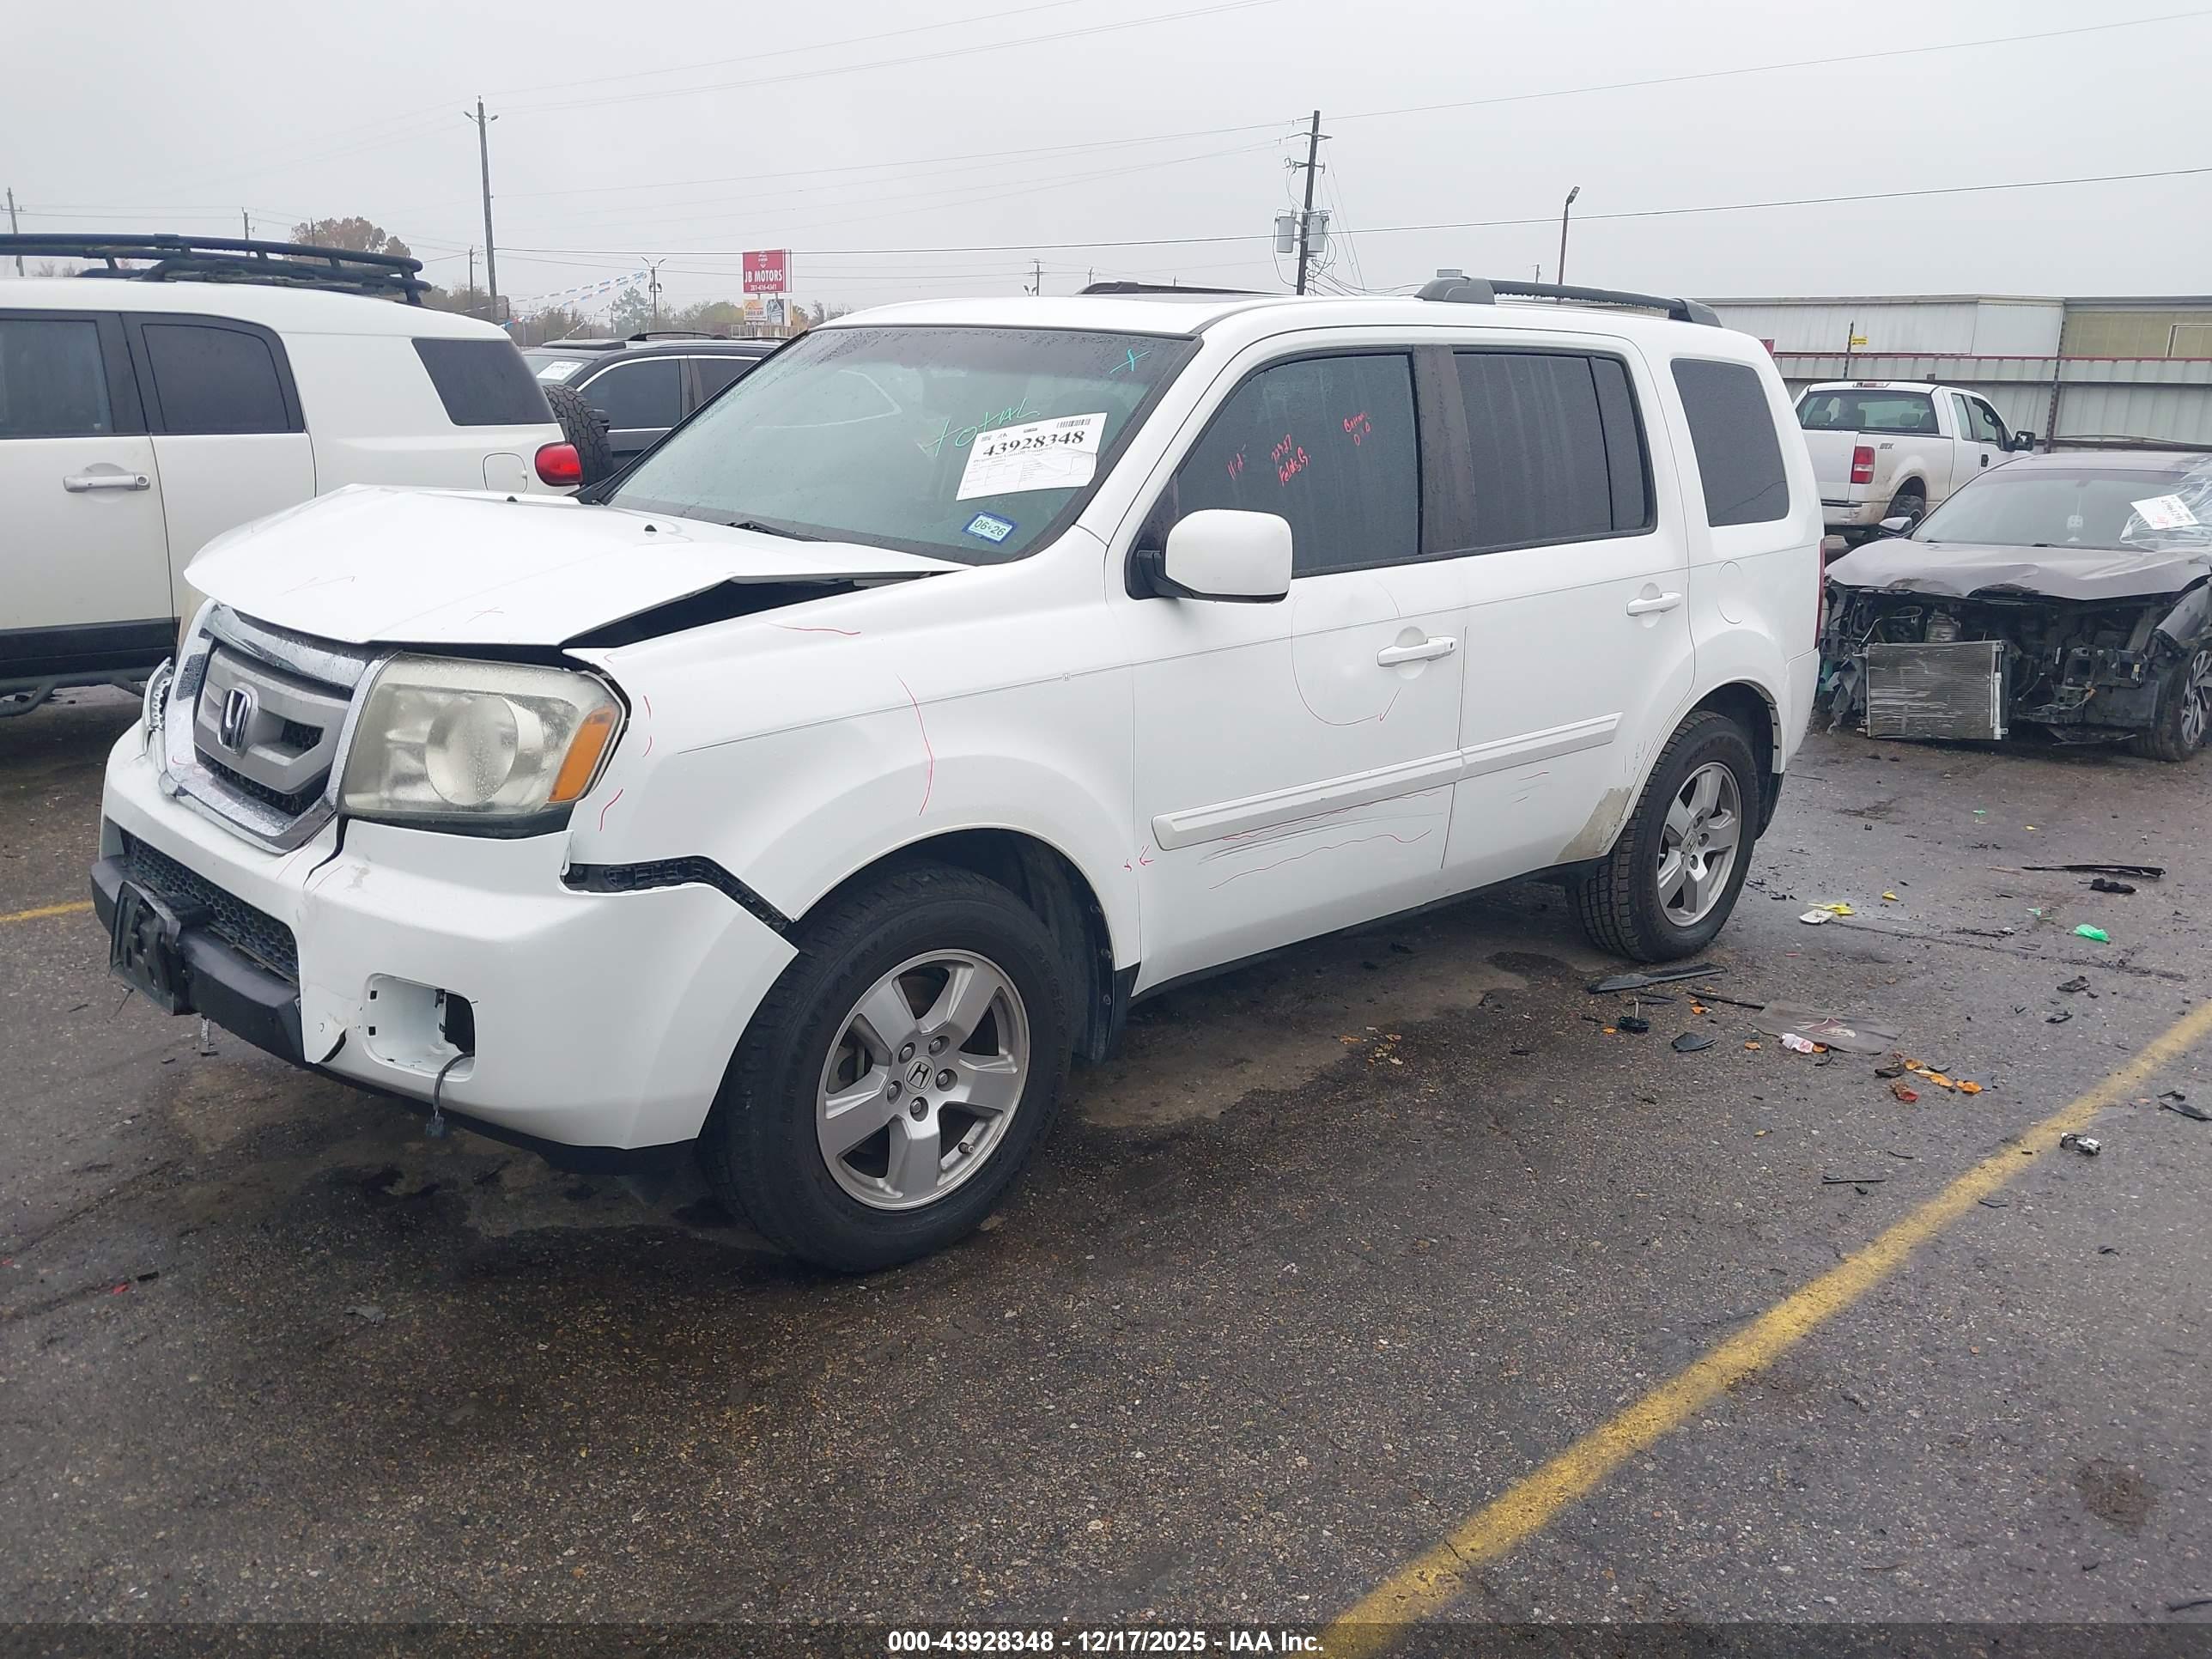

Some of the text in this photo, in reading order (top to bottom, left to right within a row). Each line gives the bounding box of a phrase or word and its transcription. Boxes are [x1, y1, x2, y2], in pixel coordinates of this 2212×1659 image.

[744, 269, 782, 283] JB MOTORS
[982, 430, 1085, 456] 43928348
